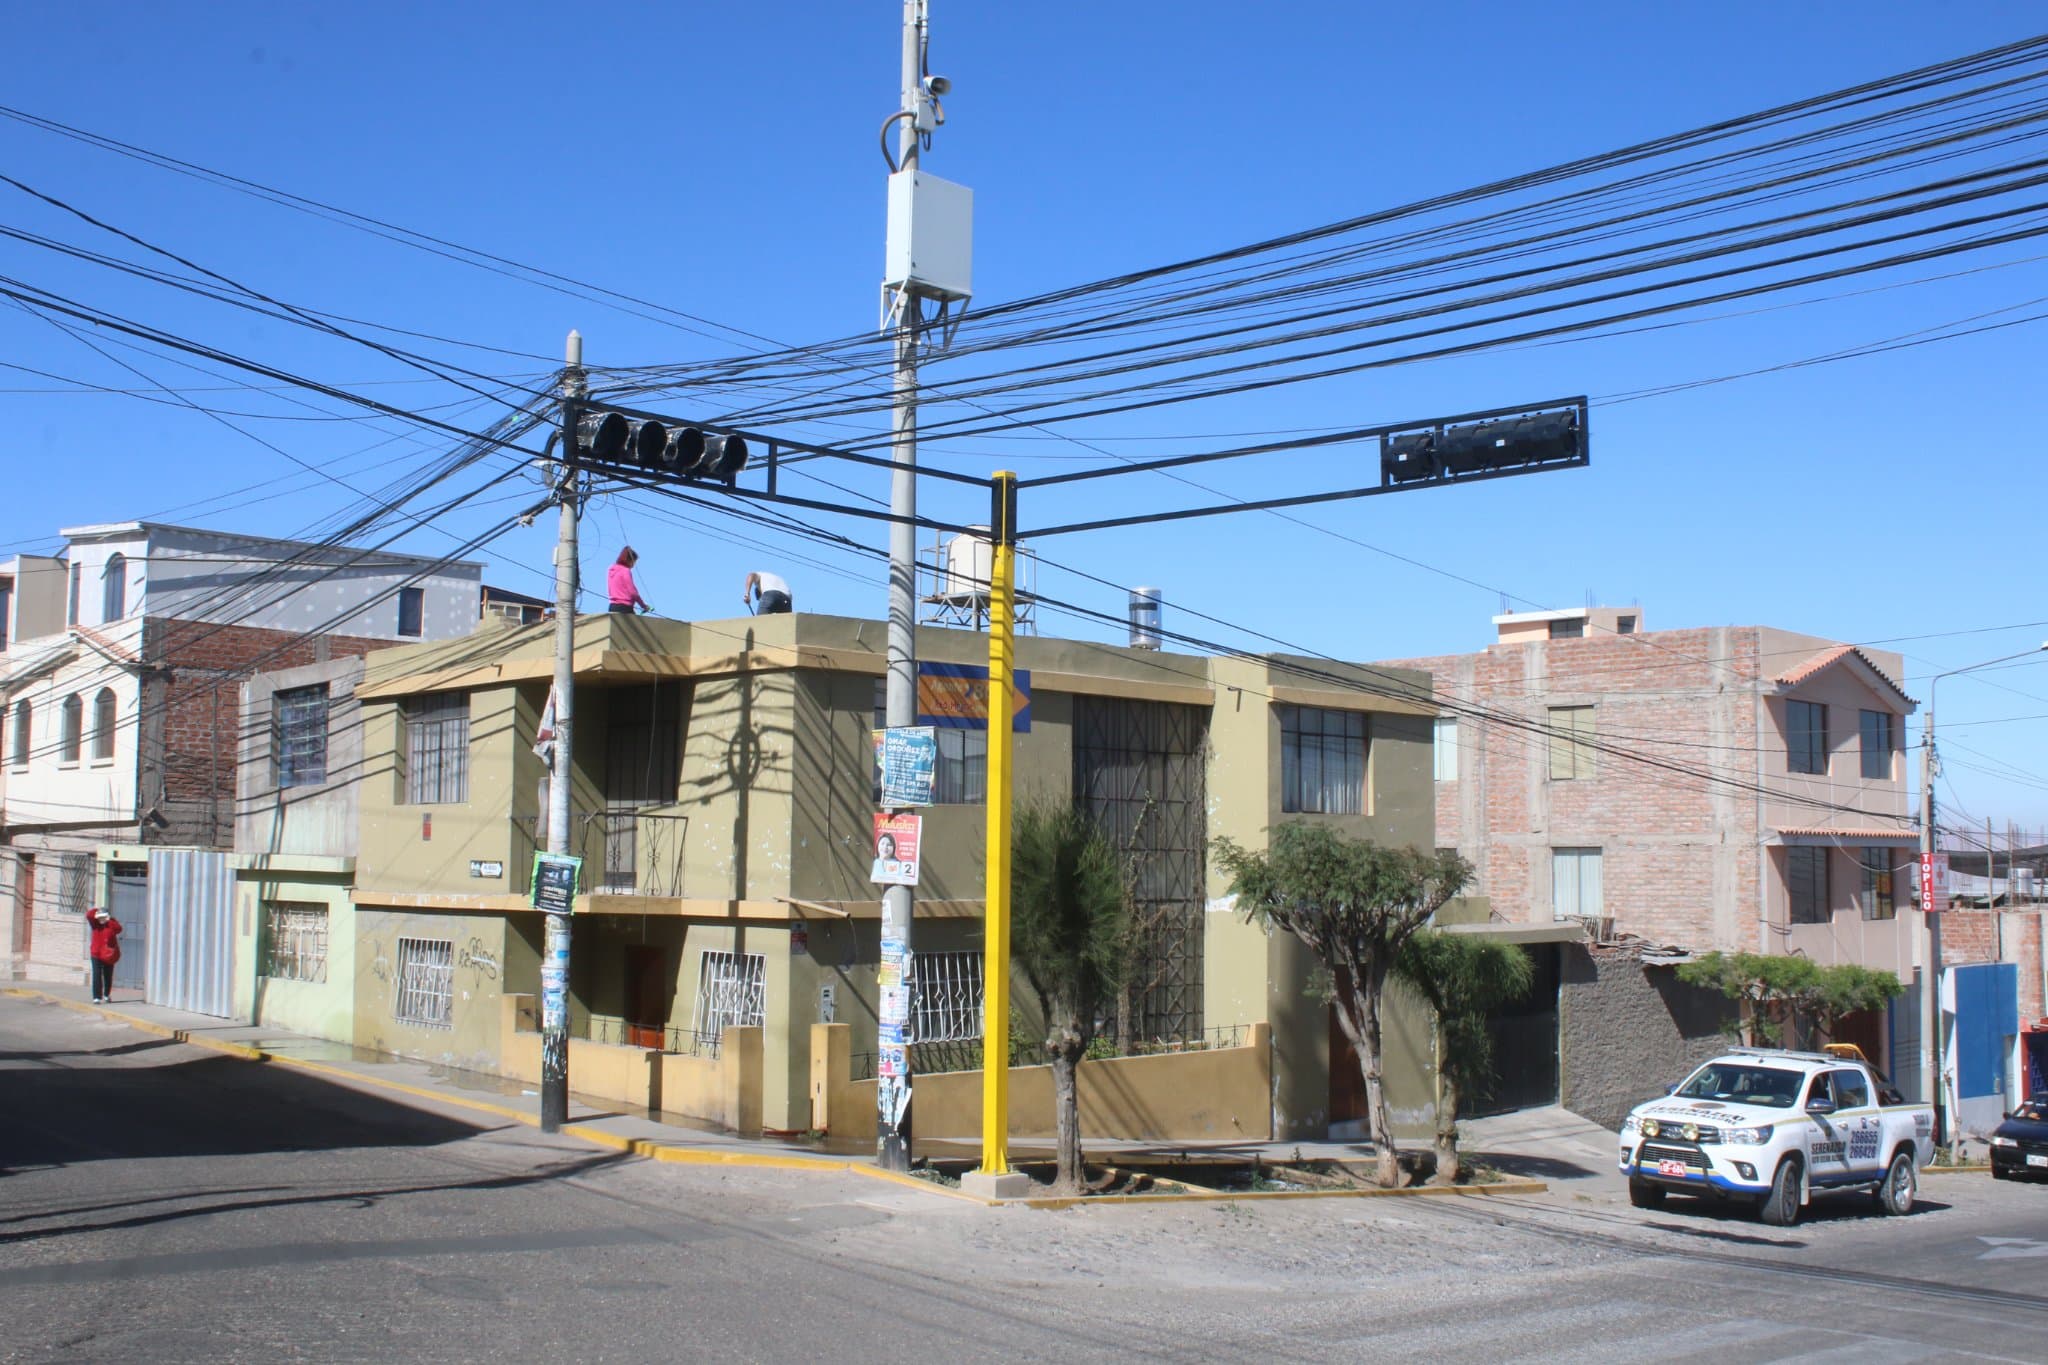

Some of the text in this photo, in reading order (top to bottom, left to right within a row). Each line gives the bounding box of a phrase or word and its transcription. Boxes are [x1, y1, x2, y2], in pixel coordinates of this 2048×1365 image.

[904, 863, 912, 874] 2
[1922, 854, 1931, 910] TOPICO
[1647, 1105, 1746, 1121] SERENAZGO
[1811, 1141, 1847, 1155] SERENAZGO
